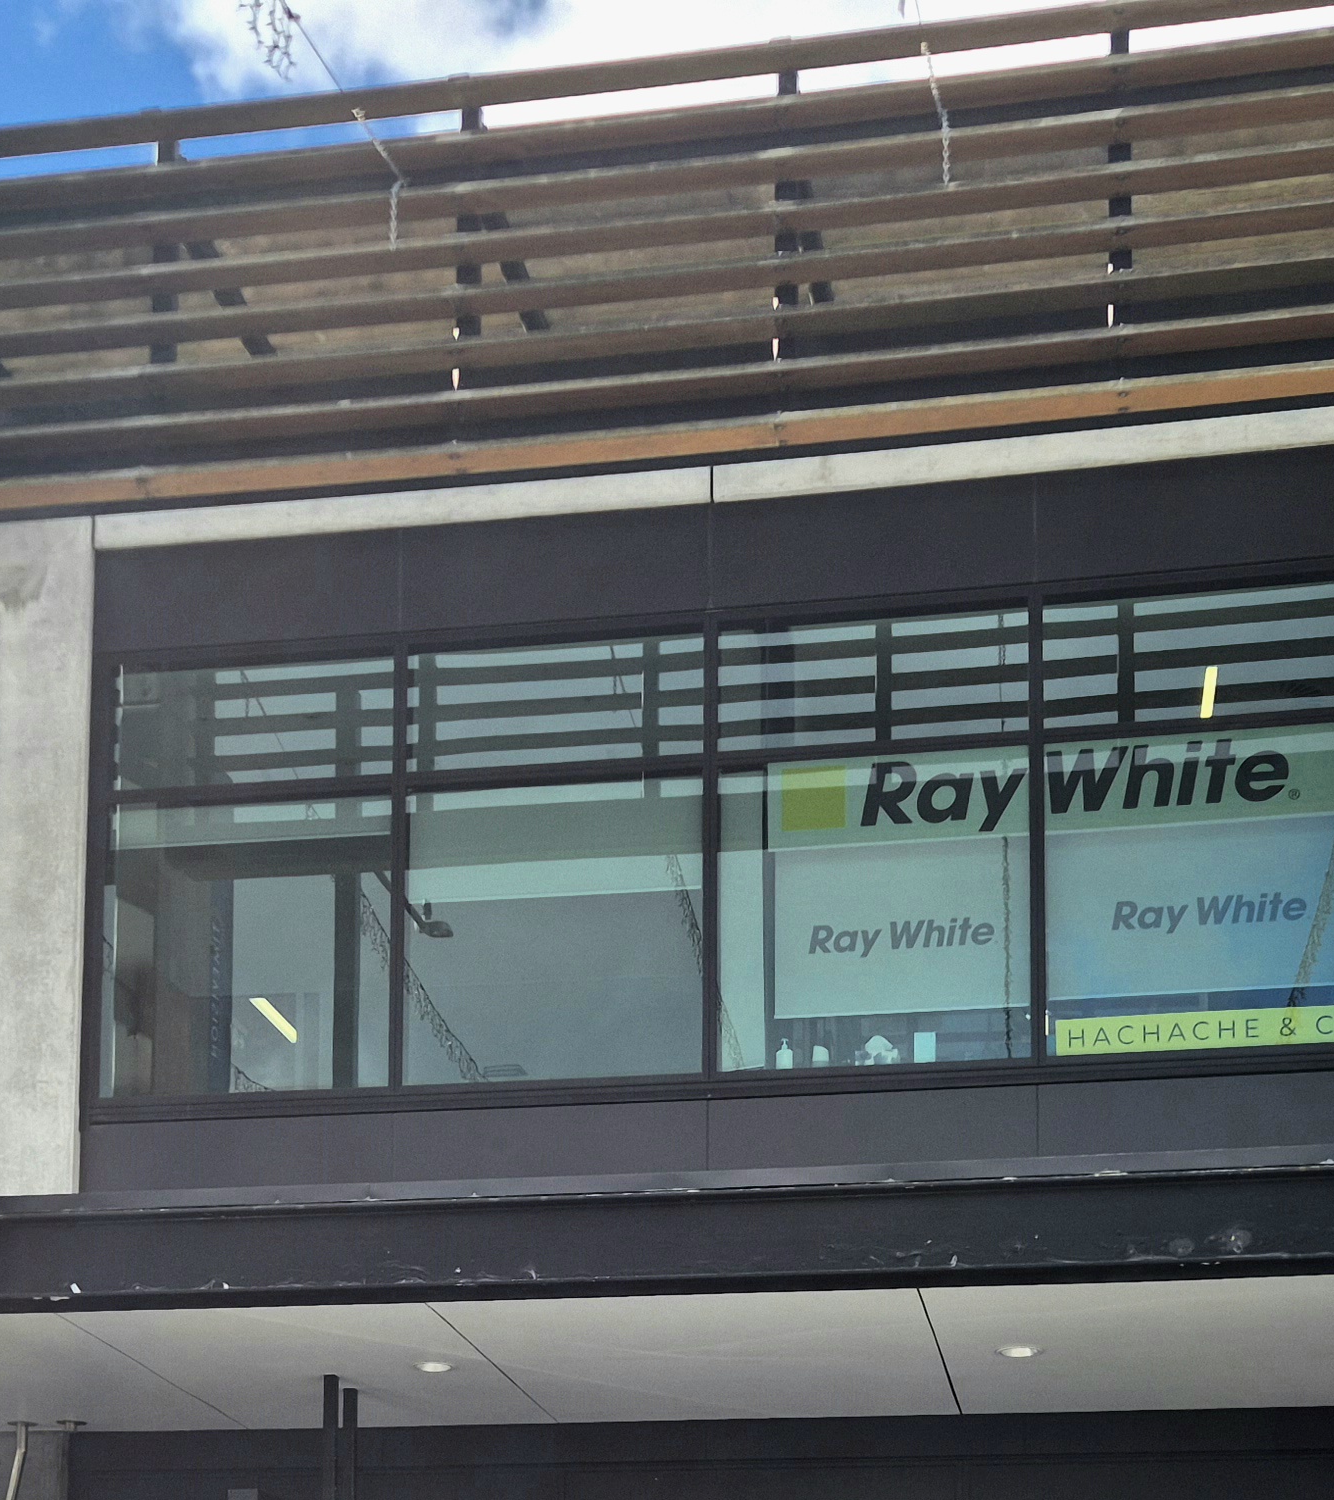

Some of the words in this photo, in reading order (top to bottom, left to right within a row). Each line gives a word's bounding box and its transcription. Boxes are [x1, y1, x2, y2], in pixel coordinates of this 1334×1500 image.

[860, 761, 1025, 832] Ray
[1045, 739, 1290, 814] White
[1111, 899, 1189, 934] Ray
[1196, 891, 1307, 925] White
[808, 924, 881, 957] Ray
[889, 917, 995, 949] White
[1066, 1018, 1262, 1048] HACHACHE
[1278, 1017, 1298, 1036] &
